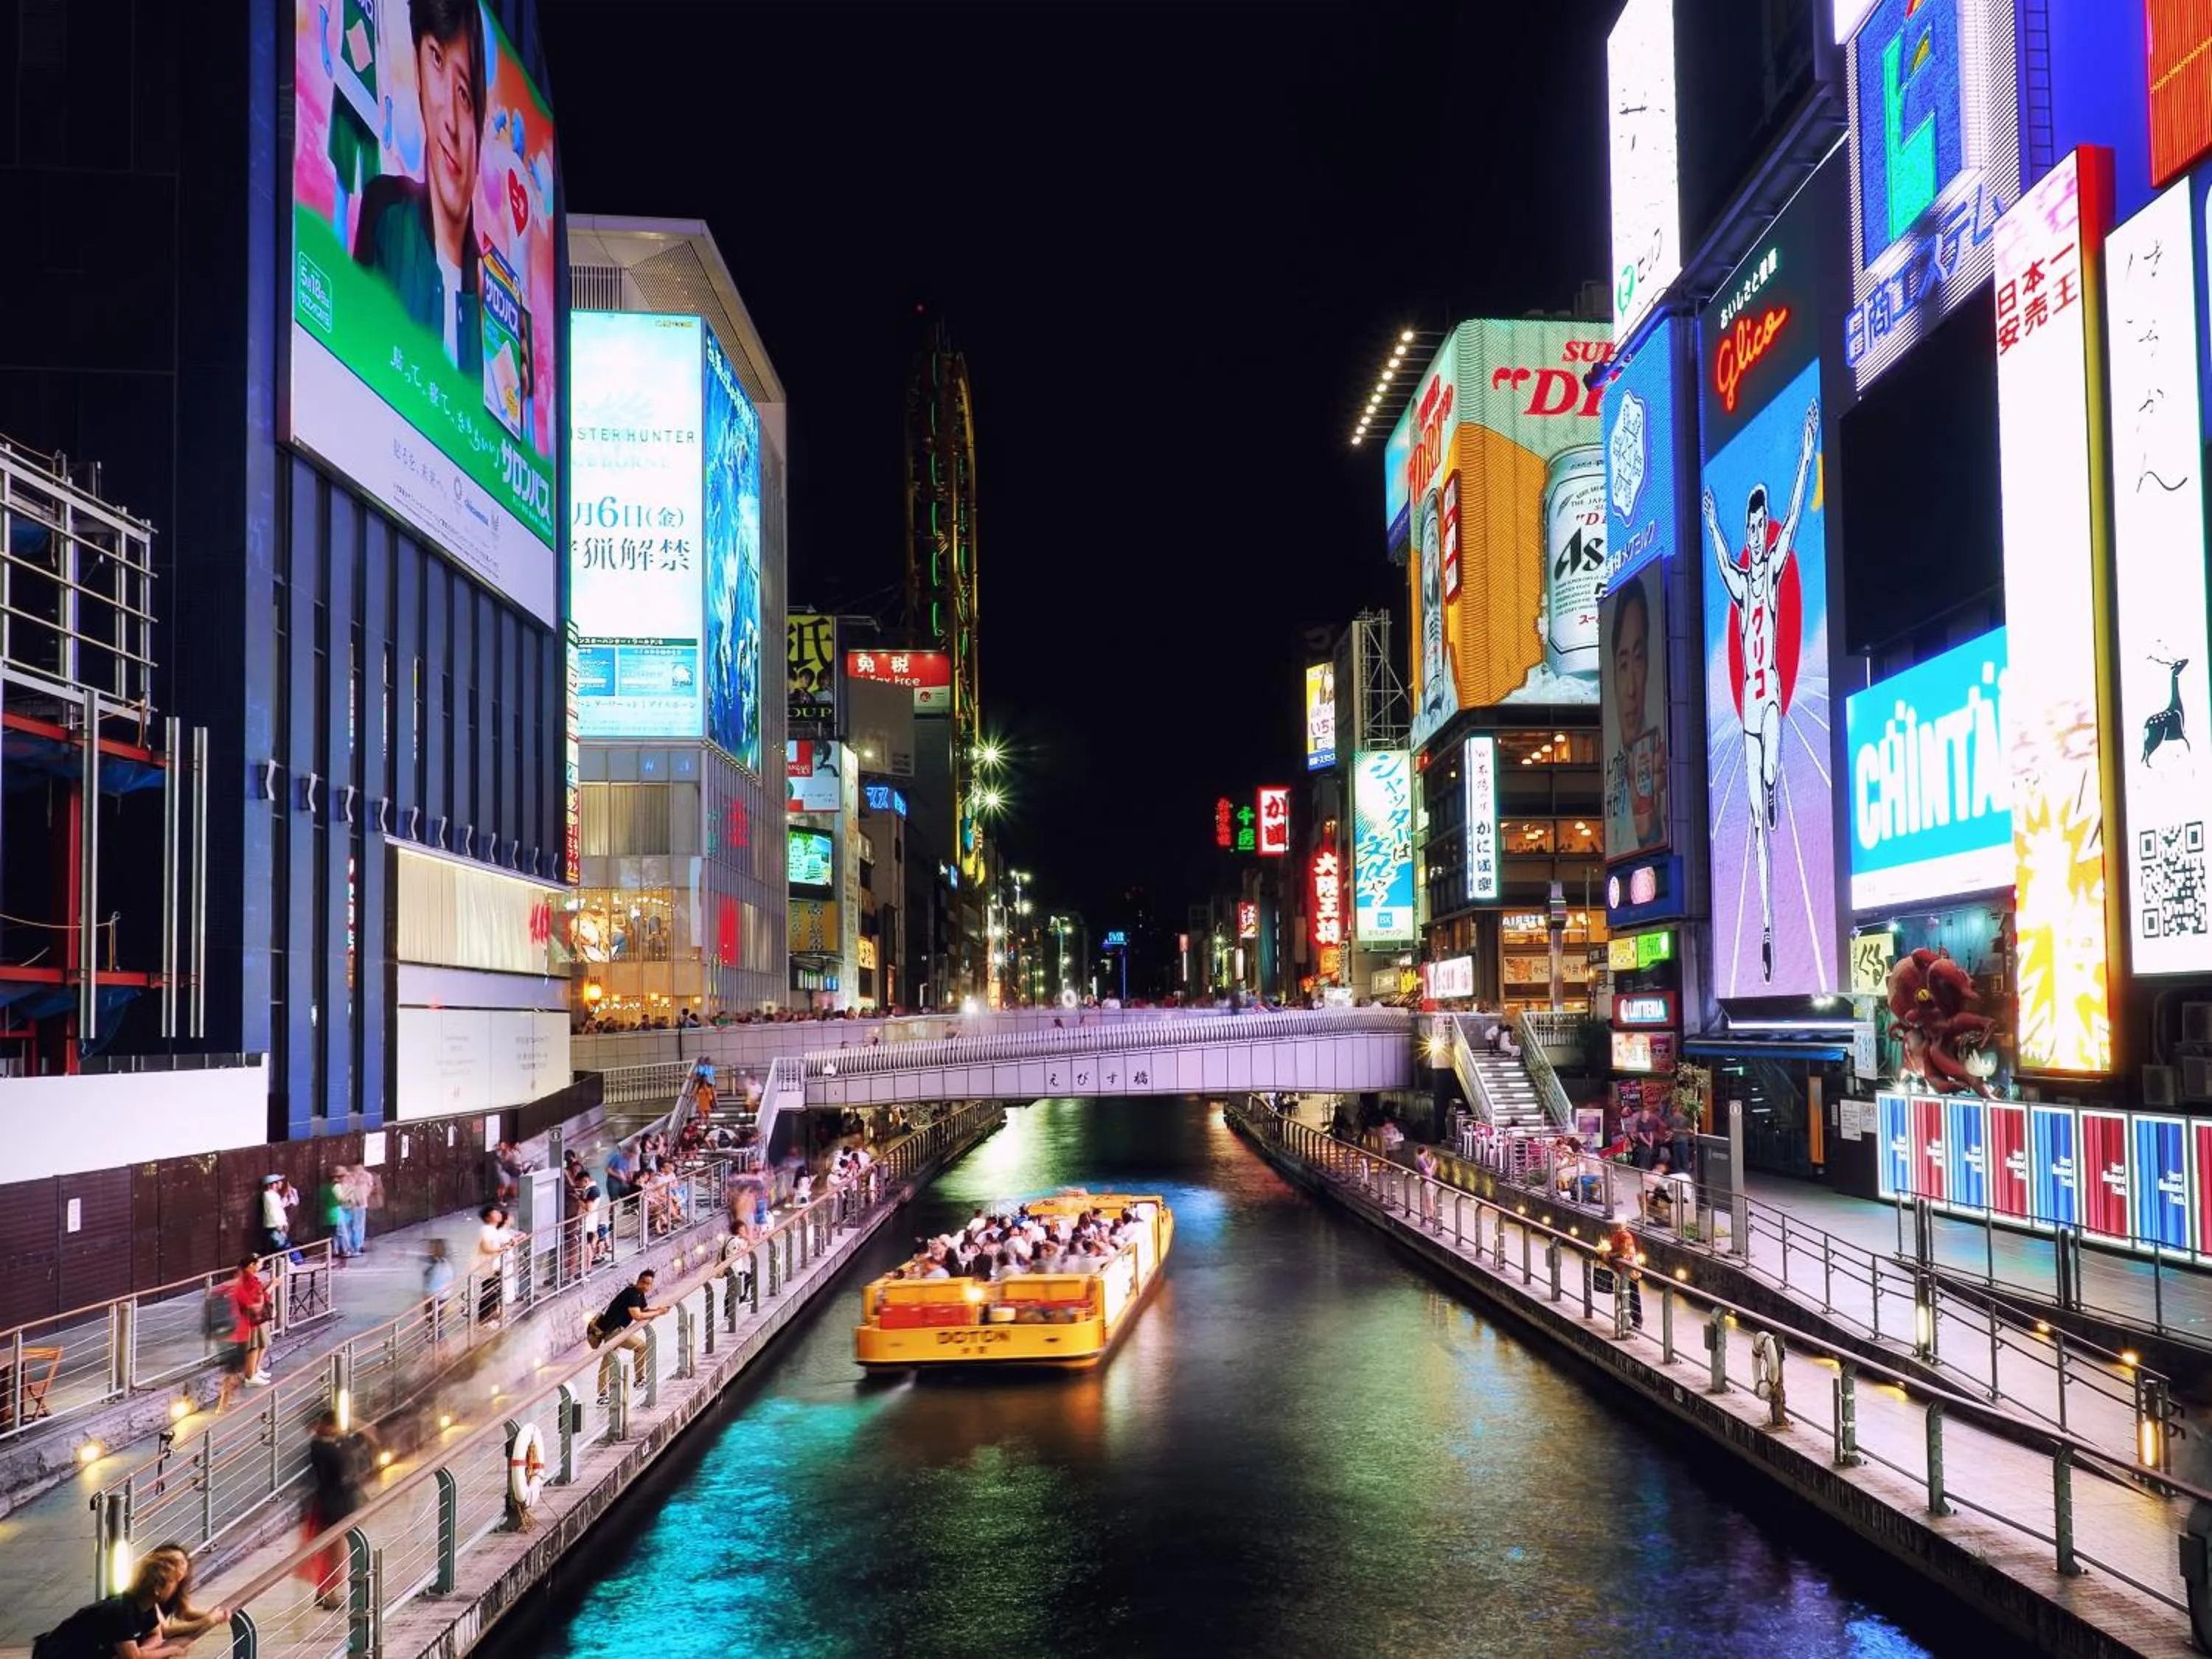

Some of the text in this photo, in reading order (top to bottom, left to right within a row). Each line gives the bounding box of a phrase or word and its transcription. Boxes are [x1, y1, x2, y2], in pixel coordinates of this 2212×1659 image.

[1997, 243, 2076, 319] 日本一
[1997, 269, 2079, 356] 安売王
[1717, 307, 1787, 411] Glico
[627, 429, 695, 443] HUNTER
[501, 438, 552, 526] サロンパス
[858, 655, 909, 674] 免税
[894, 675, 921, 686] Free
[1751, 599, 1765, 700] グリコ
[1314, 852, 1340, 944] 大阪王将
[1049, 1071, 1149, 1086] えびす橋
